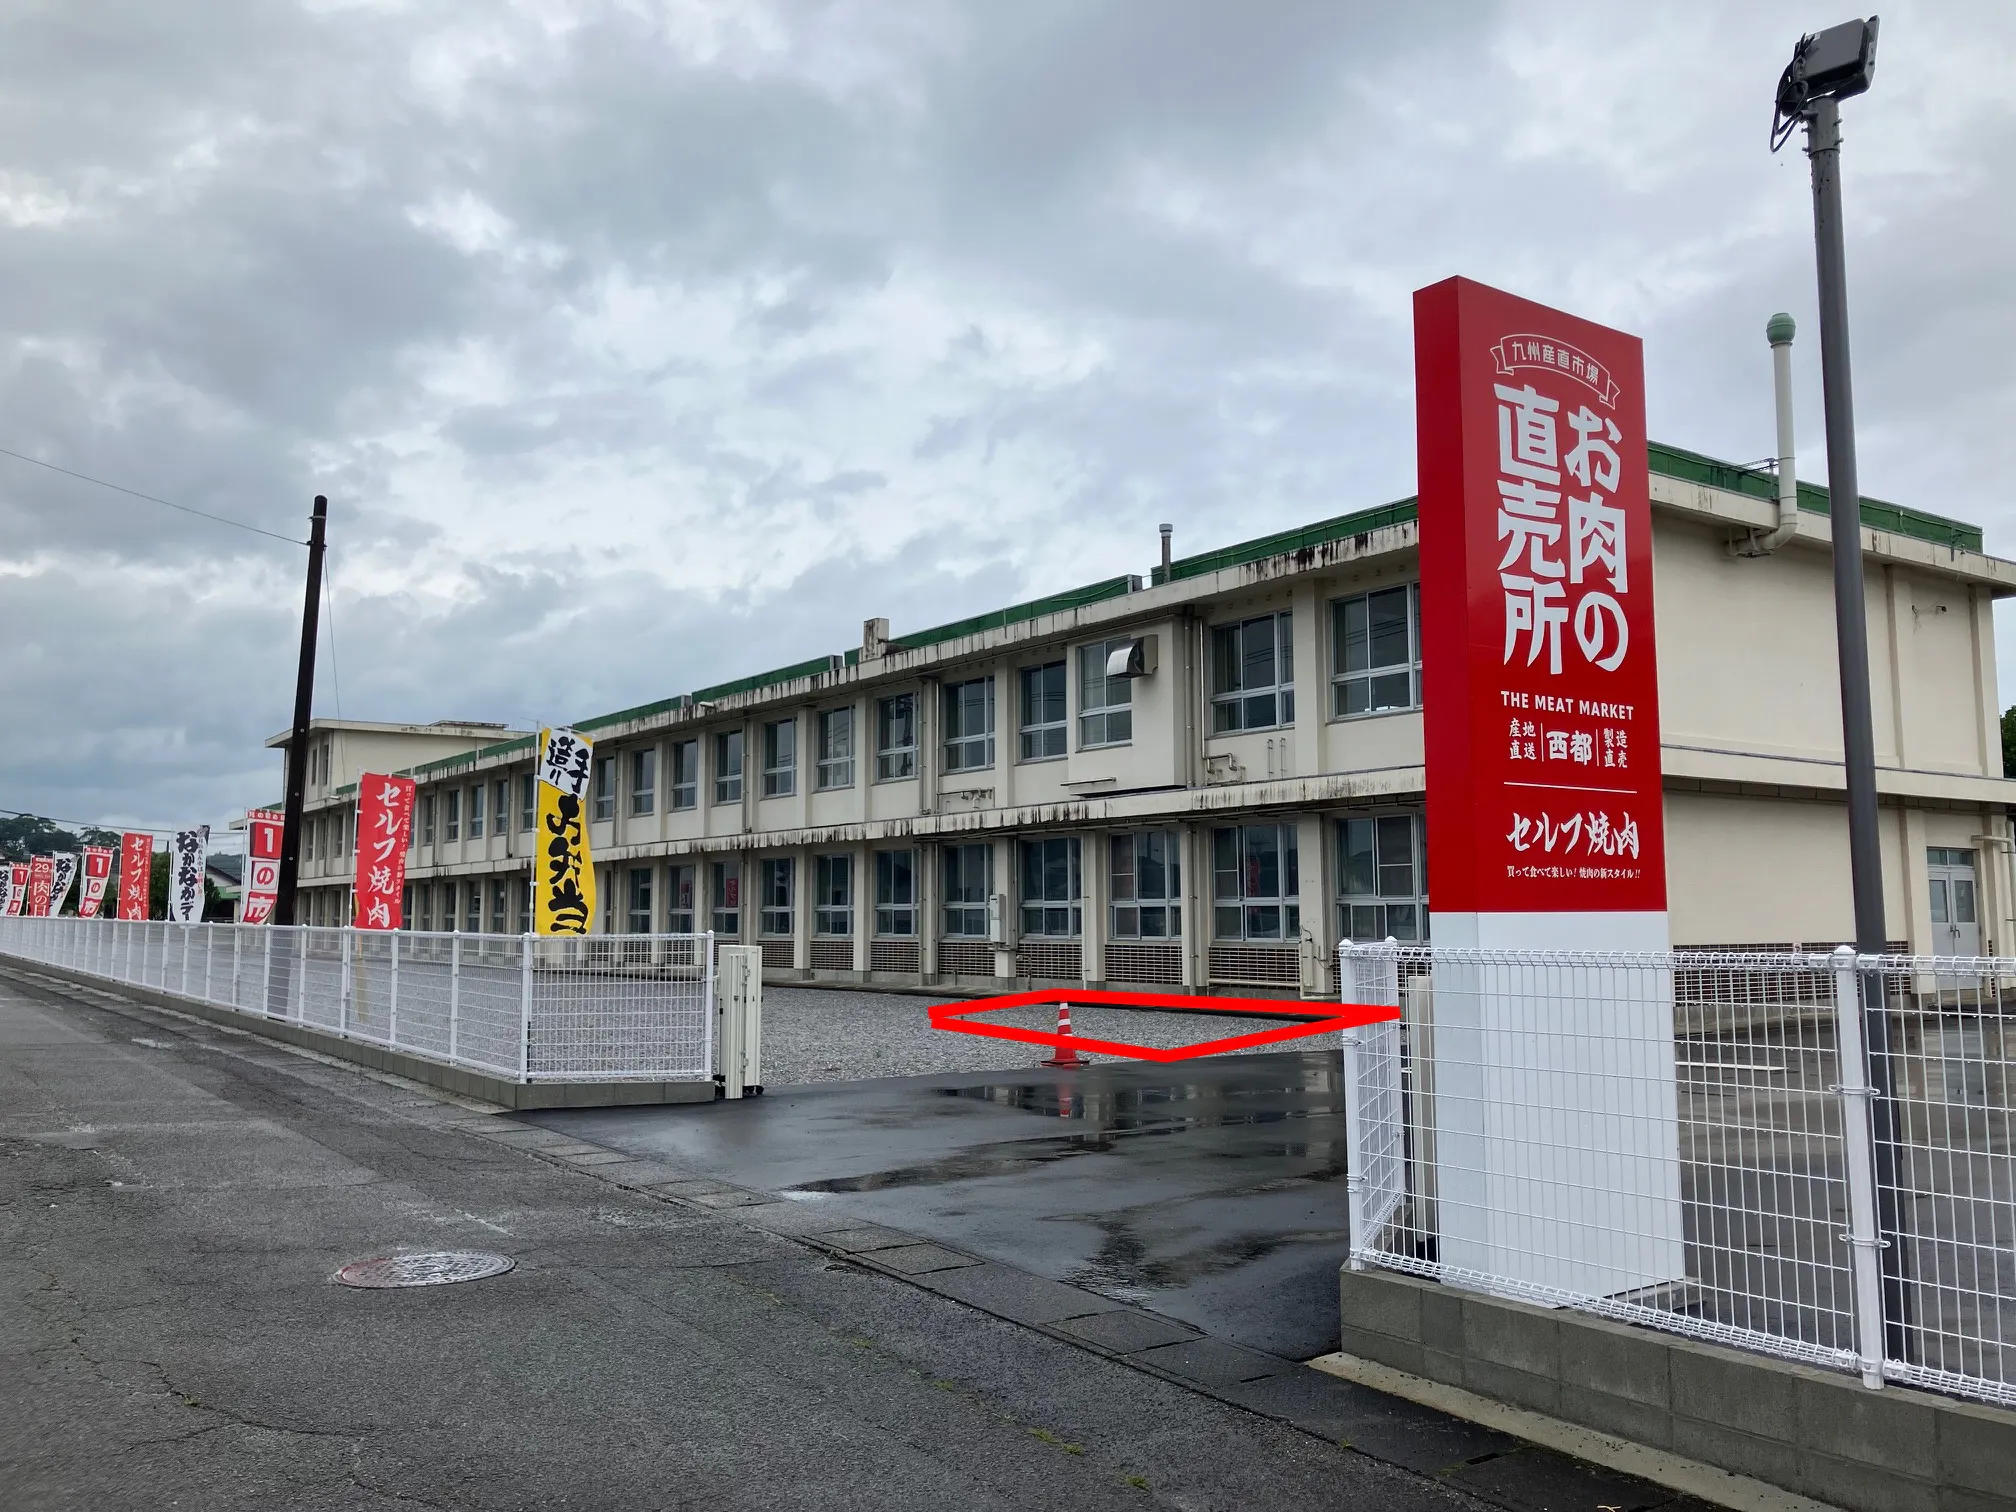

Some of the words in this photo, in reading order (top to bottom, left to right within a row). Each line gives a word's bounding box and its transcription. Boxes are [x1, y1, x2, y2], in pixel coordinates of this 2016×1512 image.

[1511, 341, 1599, 386] 九州産直市場
[1493, 383, 1569, 675] 直売所
[1564, 405, 1629, 672] お肉の
[1500, 690, 1529, 709] THE
[1534, 695, 1574, 714] MEAT
[1578, 700, 1634, 720] MARKET
[1508, 717, 1537, 738] 産地
[1603, 727, 1629, 749] 製造
[1509, 739, 1538, 760] 直送
[1545, 729, 1593, 766] 西都
[1604, 748, 1629, 768] 直売
[1506, 810, 1640, 860] セルフ焼肉
[34, 863, 50, 873] 29
[366, 782, 403, 928] セルフ焼肉
[546, 793, 589, 935] お弁当
